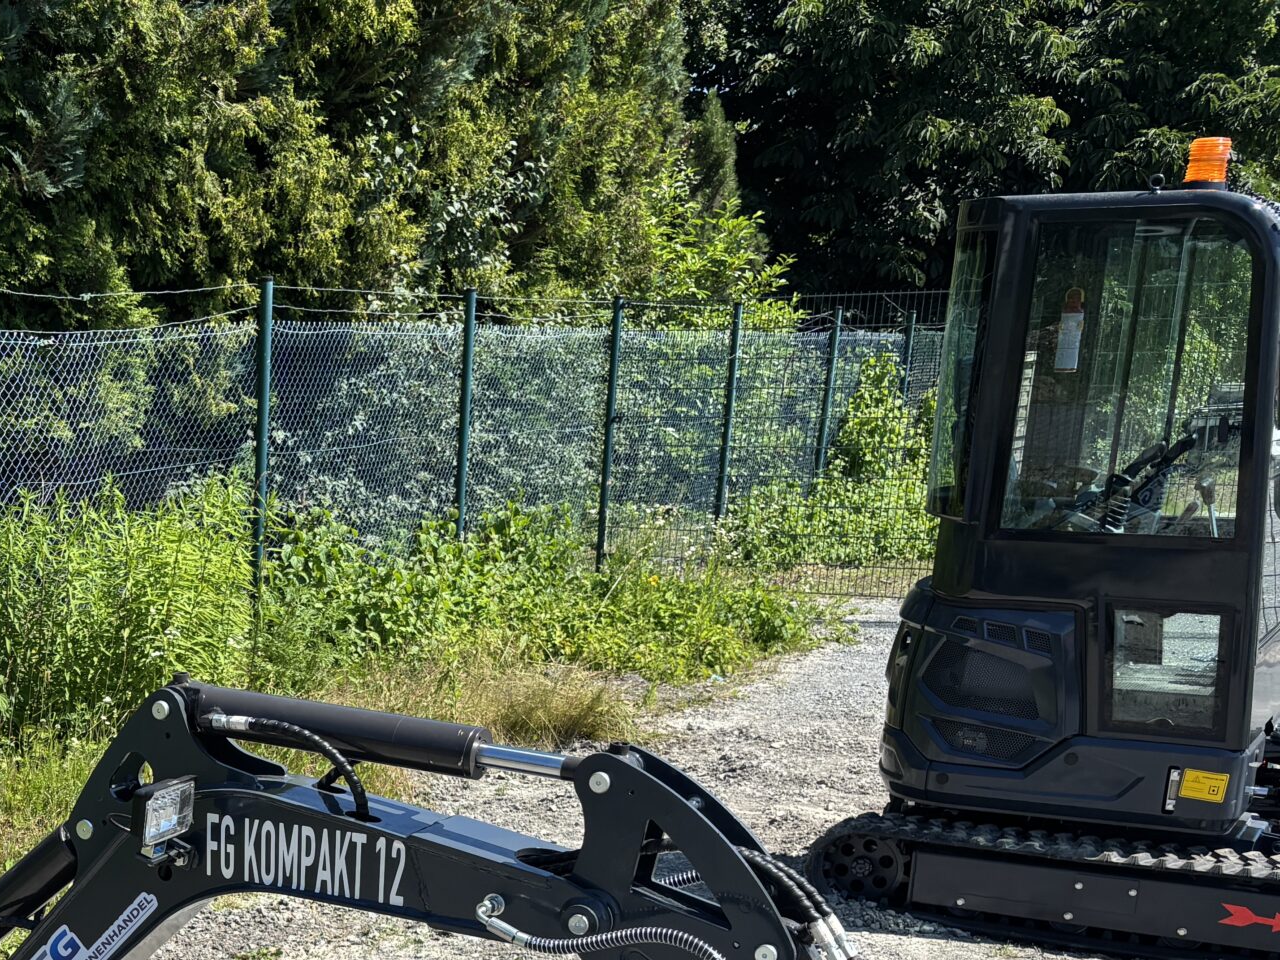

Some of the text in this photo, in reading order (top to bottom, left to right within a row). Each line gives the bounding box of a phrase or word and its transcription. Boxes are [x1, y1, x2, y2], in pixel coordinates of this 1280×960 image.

[206, 812, 406, 907] FG KOMPAKT 12
